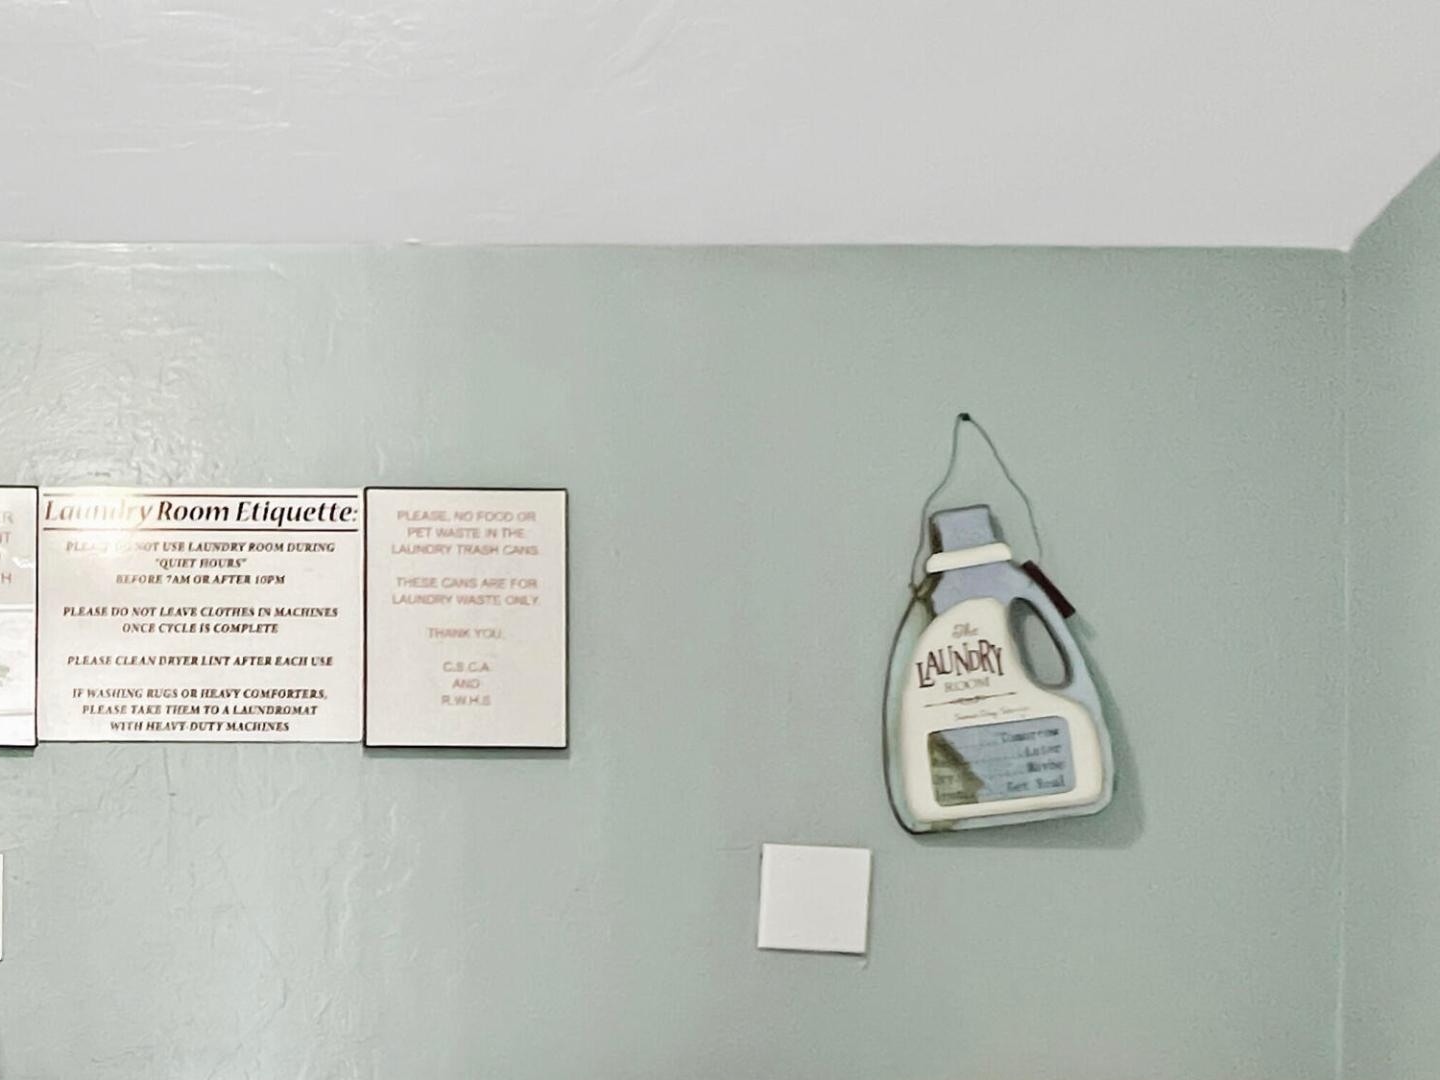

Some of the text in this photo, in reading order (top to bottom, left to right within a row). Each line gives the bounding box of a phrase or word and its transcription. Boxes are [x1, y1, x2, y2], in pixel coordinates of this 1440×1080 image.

[157, 501, 230, 522] Room
[235, 501, 358, 527] Etiquette:
[453, 510, 474, 522] NO
[476, 510, 515, 523] FOOD
[516, 511, 536, 523] OR
[407, 526, 525, 539] PET WASTE IN THE
[162, 541, 186, 553] USE
[188, 541, 246, 553] LAUNDRY
[248, 541, 285, 553] ROOM
[287, 541, 336, 553] DURING
[391, 543, 453, 555] LAUNDRY
[455, 544, 501, 556] TRASH
[155, 557, 247, 569] "QUIET HOURS"
[116, 574, 285, 585] BEFORE 7AM OR AFTER 10PM
[396, 576, 538, 589] THESE CANS ARE FOR
[392, 594, 454, 605] LAUNDRY
[456, 594, 502, 606] WASTE
[63, 606, 338, 618] PLEASE DO NOT LEAVE CLOTHES IN MACHINES
[122, 622, 279, 634] ONCE CYCLE IS COMPLETE
[426, 627, 471, 639] THANK
[67, 655, 334, 667] PLEASE CLEAN DRYER LINT AFTER EACH USE
[915, 639, 1004, 688] LAUNDRY
[452, 678, 481, 690] AND
[72, 688, 85, 700] IF
[87, 688, 143, 700] WASHING
[146, 688, 178, 700] RUGS
[181, 688, 198, 700] OR
[200, 688, 240, 700] HEAVY
[82, 704, 318, 716] PLEASE TAKE THEM TO A LAUNDROMAT
[110, 721, 143, 732] WITH
[226, 721, 290, 732] MACHINES
